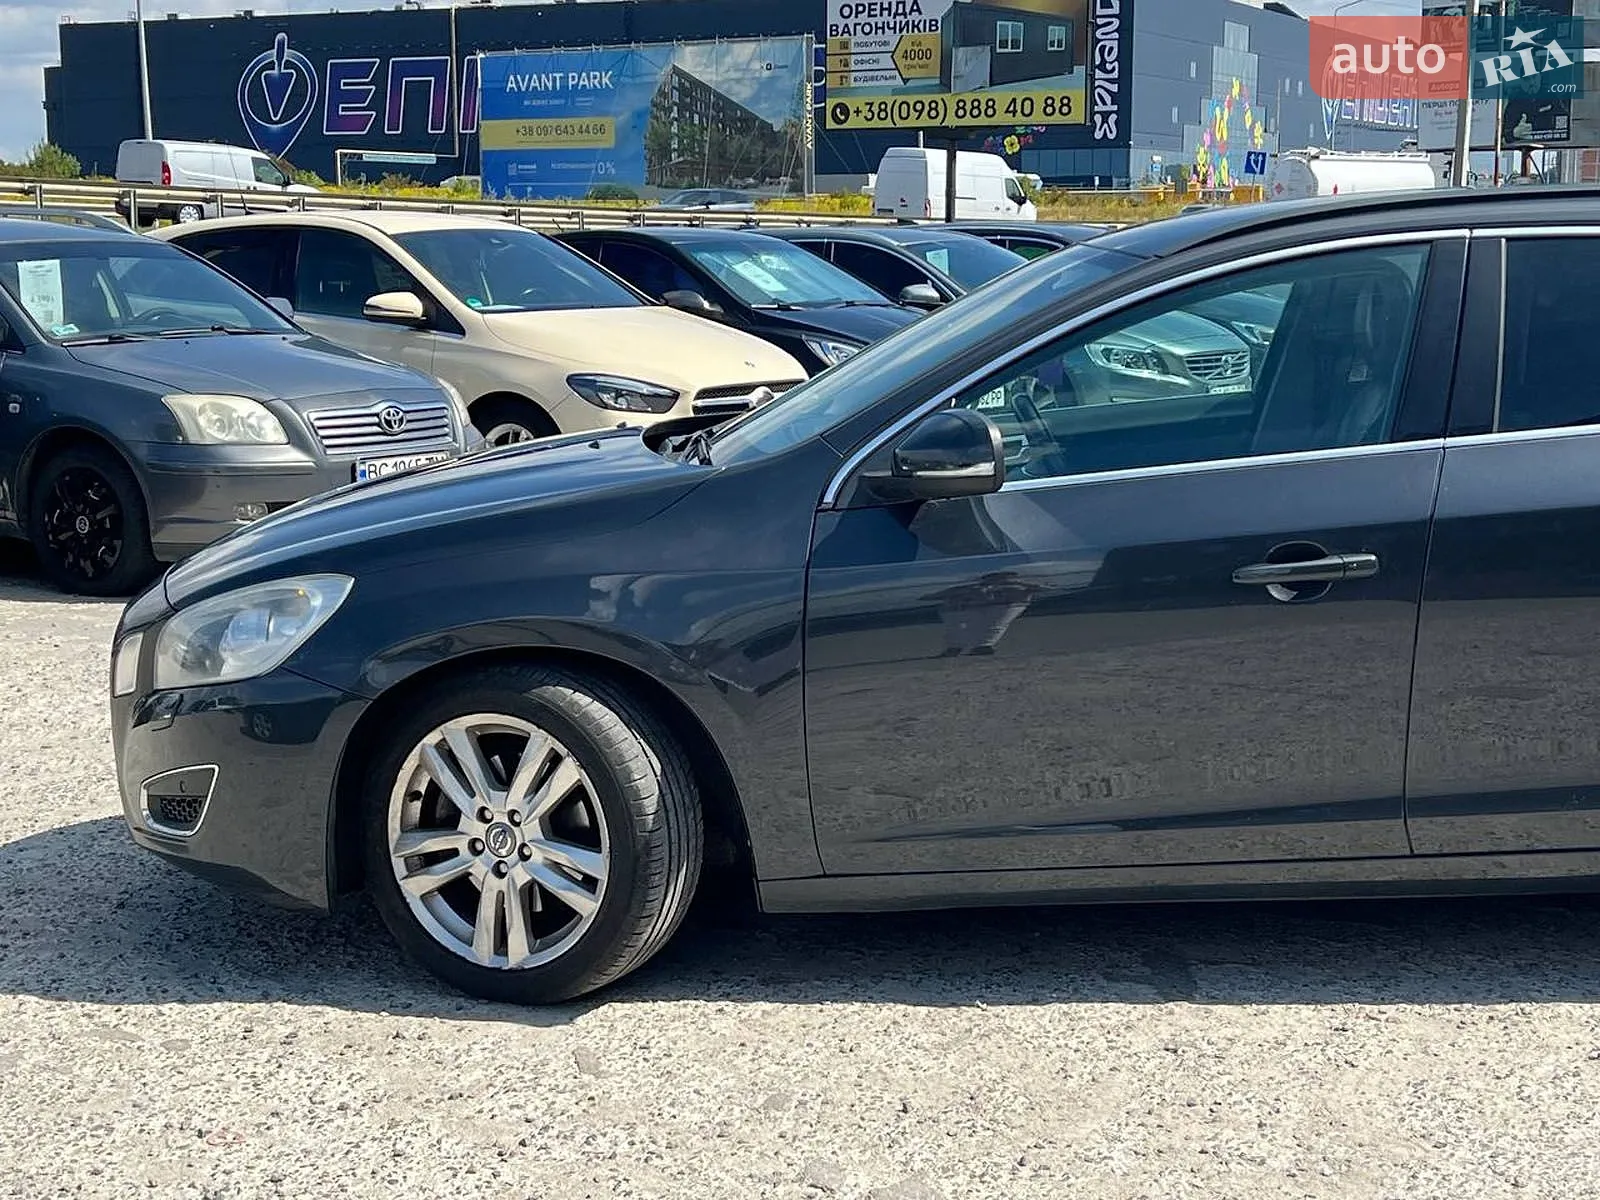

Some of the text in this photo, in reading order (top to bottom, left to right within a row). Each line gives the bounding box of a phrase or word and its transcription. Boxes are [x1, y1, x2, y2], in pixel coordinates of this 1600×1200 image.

[839, 0, 922, 19] ОРЕНДА
[829, 19, 940, 37] ВАГОНЧИКІВ
[902, 48, 932, 60] 4000
[506, 70, 614, 92] AVANT PARK
[853, 96, 1072, 126] +38(098) 888 40 88
